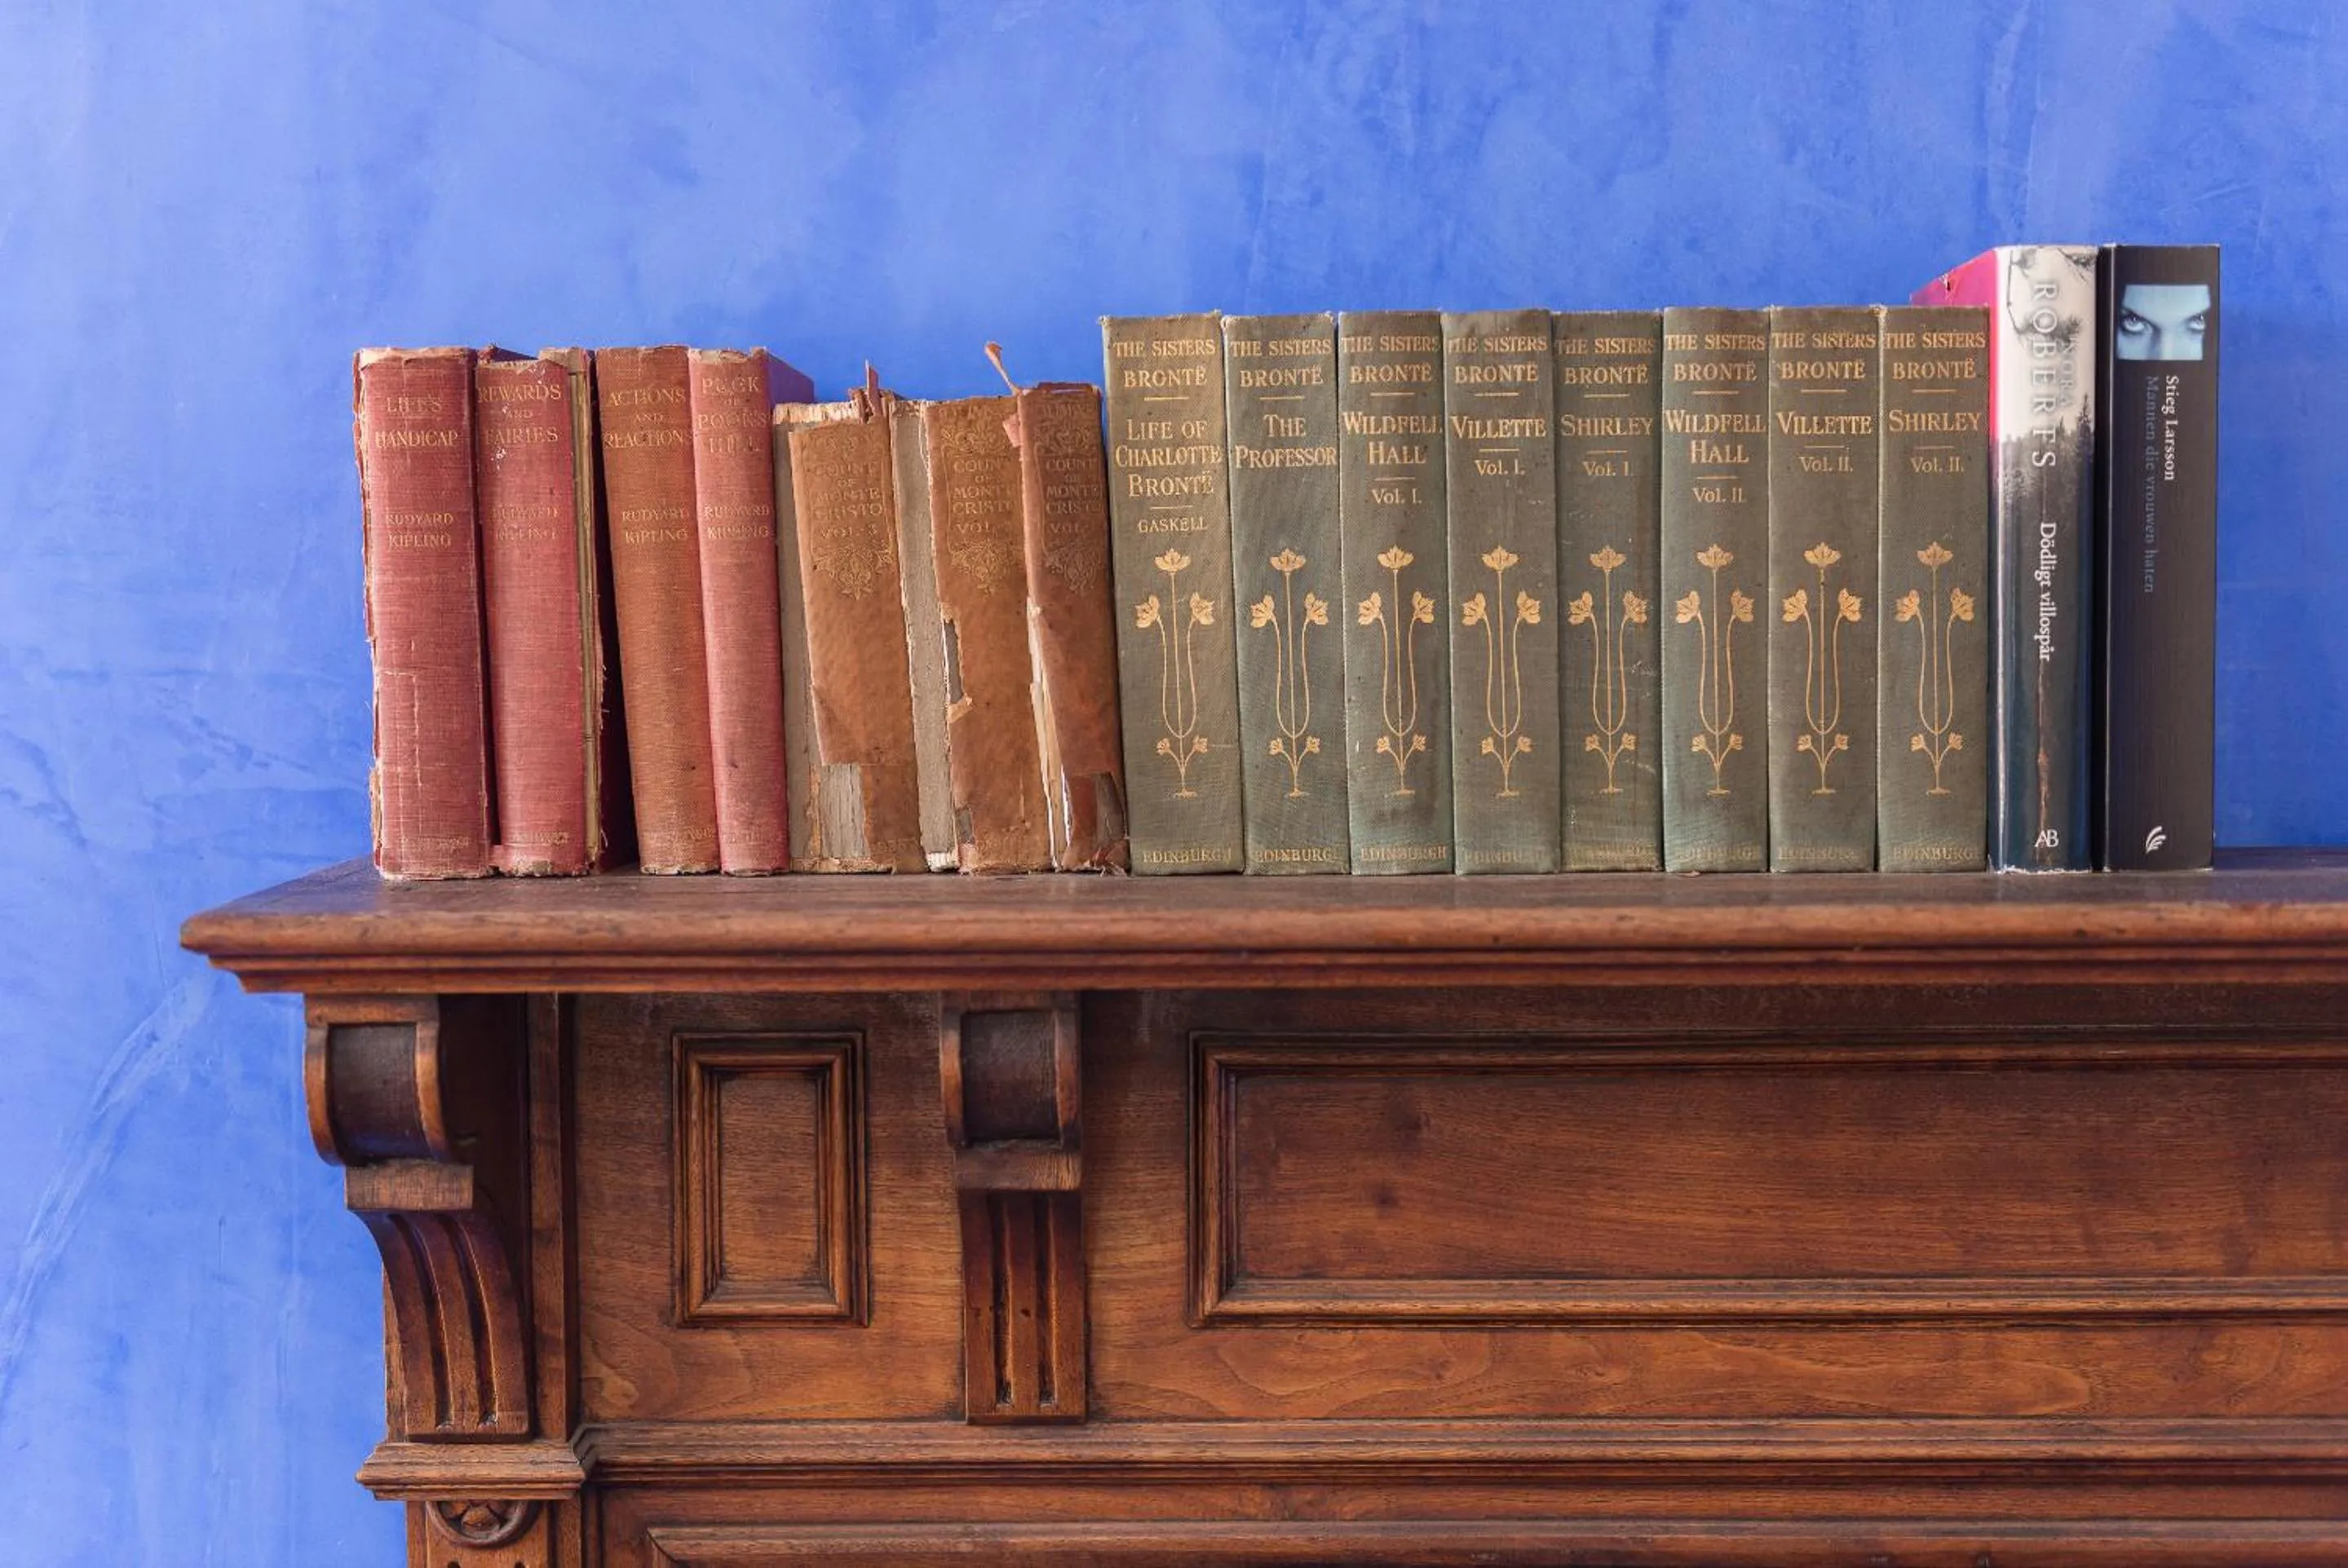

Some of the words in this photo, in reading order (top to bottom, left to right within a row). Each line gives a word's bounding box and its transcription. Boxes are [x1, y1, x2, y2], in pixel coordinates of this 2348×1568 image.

[1113, 341, 1145, 357] THE
[1152, 338, 1215, 356] SISTERS
[1230, 340, 1262, 357] THE
[1269, 338, 1333, 356] SISTERS
[1342, 336, 1373, 354] THE
[1380, 335, 1440, 352] SISTERS
[1448, 336, 1479, 354] THE
[1484, 335, 1548, 353] SISTERS
[1555, 338, 1588, 356] THE
[1594, 338, 1655, 354] SISTERS
[1665, 334, 1697, 351] THE
[1705, 334, 1766, 351] SISTERS
[1772, 333, 1805, 349] THE
[1811, 333, 1876, 349] SISTERS
[1883, 332, 1915, 349] THE
[1922, 332, 1986, 349] SISTERS
[1124, 366, 1209, 388] BRONTË
[1240, 365, 1324, 388] BRONTË
[1350, 362, 1433, 384] BRONTË
[1454, 361, 1540, 383] BRONTË
[1564, 364, 1648, 385] BRONTË
[1674, 360, 1758, 382] BRONTË
[1781, 359, 1866, 380] BRONTË
[1893, 358, 1977, 380] BRONTË
[2032, 283, 2058, 467] ROBERTS
[2059, 338, 2077, 409] NORA
[477, 384, 562, 403] REWARDS
[702, 377, 761, 395] PUCK
[2161, 375, 2180, 415] Stieg
[608, 388, 686, 407] ACTIONS
[2144, 375, 2160, 440] Mannen
[633, 413, 664, 425] AND
[1263, 414, 1307, 438] THE
[1343, 412, 1442, 435] WILDFELL
[1451, 415, 1546, 439] VILLETTE
[1561, 414, 1653, 436] SHIRLEY
[1665, 409, 1766, 434] WILDFELL
[1776, 411, 1872, 435] VILLETTE
[1888, 409, 1981, 432] SHIRLEY
[375, 430, 458, 448] HANDICAP
[485, 426, 559, 444] FAIRIES
[1126, 419, 1173, 441] LIFE
[1182, 420, 1208, 439] OF
[1115, 445, 1222, 467] CHARLOTTE
[1235, 444, 1338, 468] PROFESSOR
[1369, 441, 1428, 465] HALL
[1691, 440, 1749, 464] HALL
[2144, 446, 2160, 471] die
[2164, 419, 2179, 481] Larsson
[1475, 459, 1508, 476] Vol.
[1582, 461, 1616, 477] Vol.
[1798, 456, 1833, 473] Vol.
[1910, 457, 1943, 474] Vol.
[1129, 470, 1214, 497] BRONTË
[1372, 488, 1405, 504] Vol.
[1692, 488, 1727, 504] Vol.
[386, 512, 453, 528] RUDYARD
[621, 507, 689, 523] RUDYARD
[704, 506, 769, 519] RUDYARD
[2144, 475, 2158, 544] vrouwen
[707, 525, 769, 541] KIPLING
[1138, 516, 1208, 534] GASKELL
[388, 532, 452, 549] KIPLING
[625, 528, 688, 544] KIPLING
[2034, 522, 2057, 587] Dödligt
[2143, 549, 2160, 594] haten
[2033, 592, 2057, 662] villospår
[2035, 828, 2059, 847] AB
